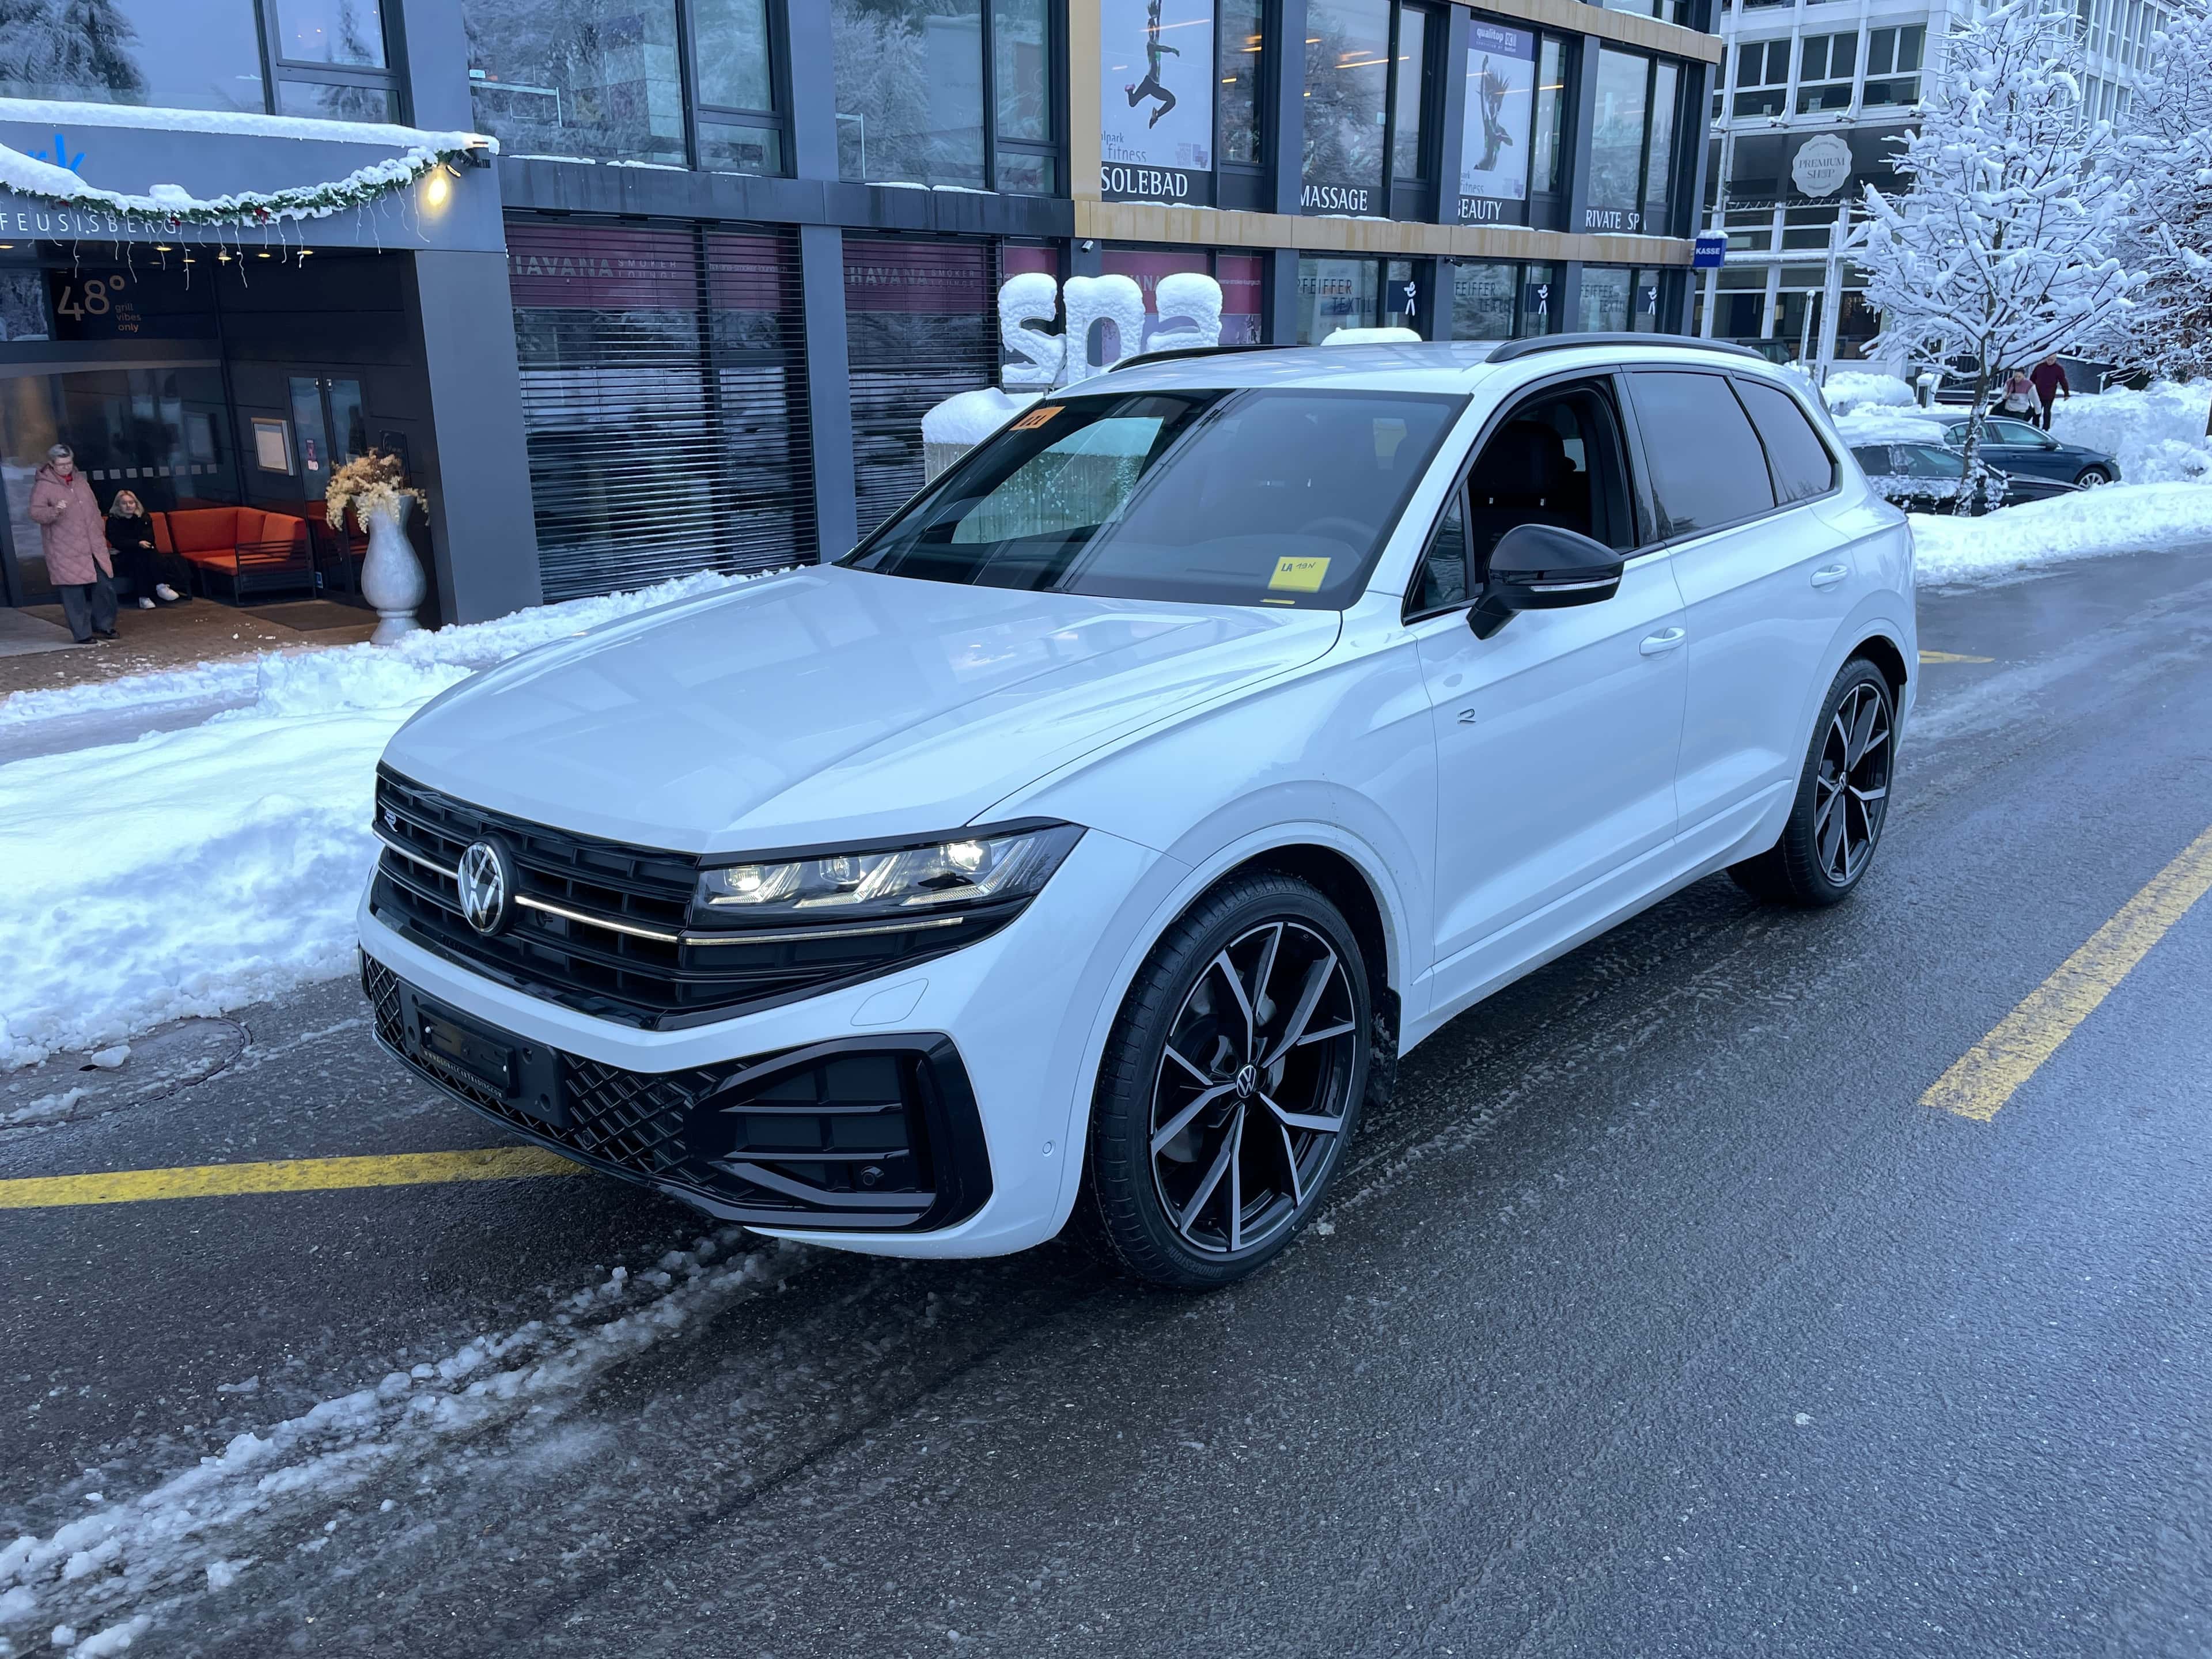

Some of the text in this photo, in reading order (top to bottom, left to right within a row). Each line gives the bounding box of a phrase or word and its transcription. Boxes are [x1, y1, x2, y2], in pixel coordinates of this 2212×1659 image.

[1476, 28, 1503, 43] qualitop
[1108, 143, 1147, 162] fitness
[1799, 157, 1844, 168] PREMIUM
[1101, 166, 1188, 197] SOLEBAD
[1806, 169, 1835, 179] SHOP
[1301, 185, 1368, 211] MASSAGE
[0, 213, 176, 233] FEUSISBERG
[1586, 210, 1622, 229] RIVATE
[618, 259, 676, 268] SMOKER
[850, 267, 974, 286] HAVANA SMOKER
[1455, 281, 1496, 296] FEIFFER
[58, 275, 125, 321] 48°
[115, 303, 134, 313] grill
[116, 313, 142, 321] vibes
[118, 323, 139, 332] only
[1281, 562, 1293, 571] LA
